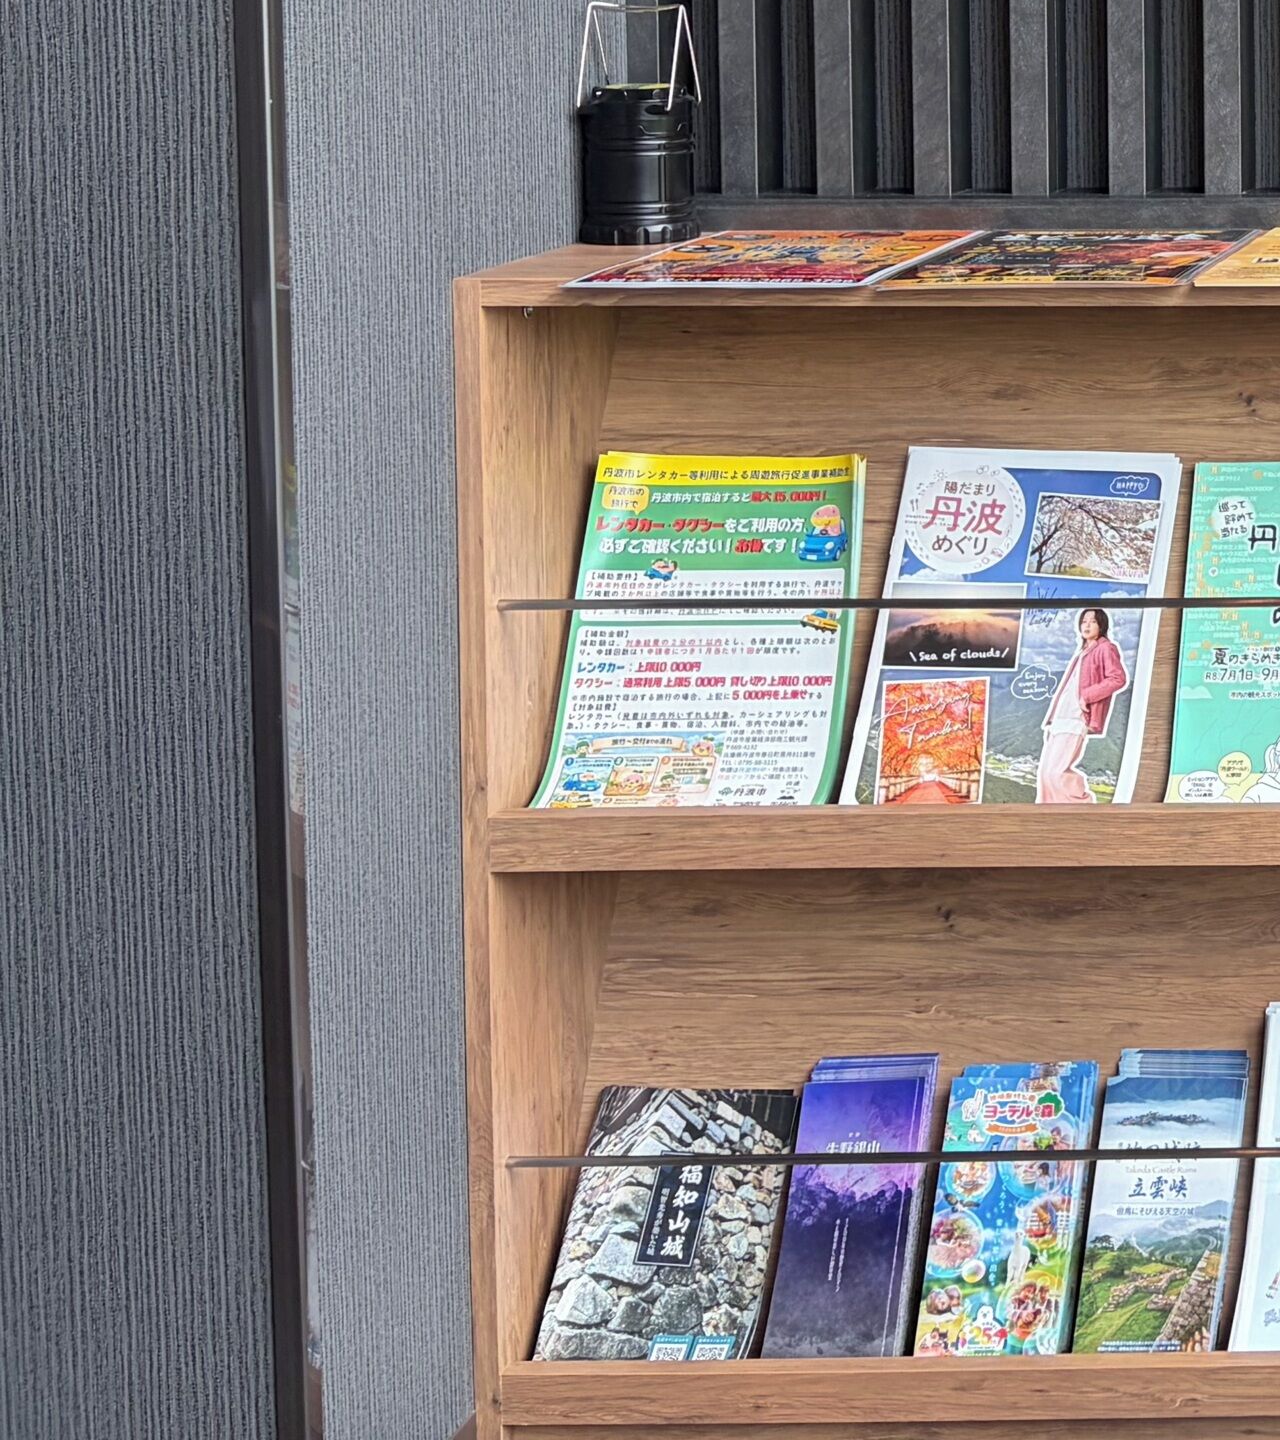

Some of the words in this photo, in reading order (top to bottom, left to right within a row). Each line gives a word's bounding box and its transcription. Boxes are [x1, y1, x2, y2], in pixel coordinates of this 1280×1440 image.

[943, 480, 996, 497] 陽だまり
[922, 496, 1006, 536] 丹波
[932, 535, 989, 555] めぐり
[918, 651, 938, 661] Sea
[942, 649, 957, 662] of
[960, 649, 1001, 659] clouds
[983, 1103, 1056, 1120] ヨーデルの森
[825, 1140, 881, 1154] 生野銀山
[1152, 1165, 1176, 1174] Castle
[1128, 1175, 1189, 1200] 立雲峡
[660, 1164, 704, 1260] 福知山城
[1116, 1206, 1194, 1217] 但馬にそびえる天空の城
